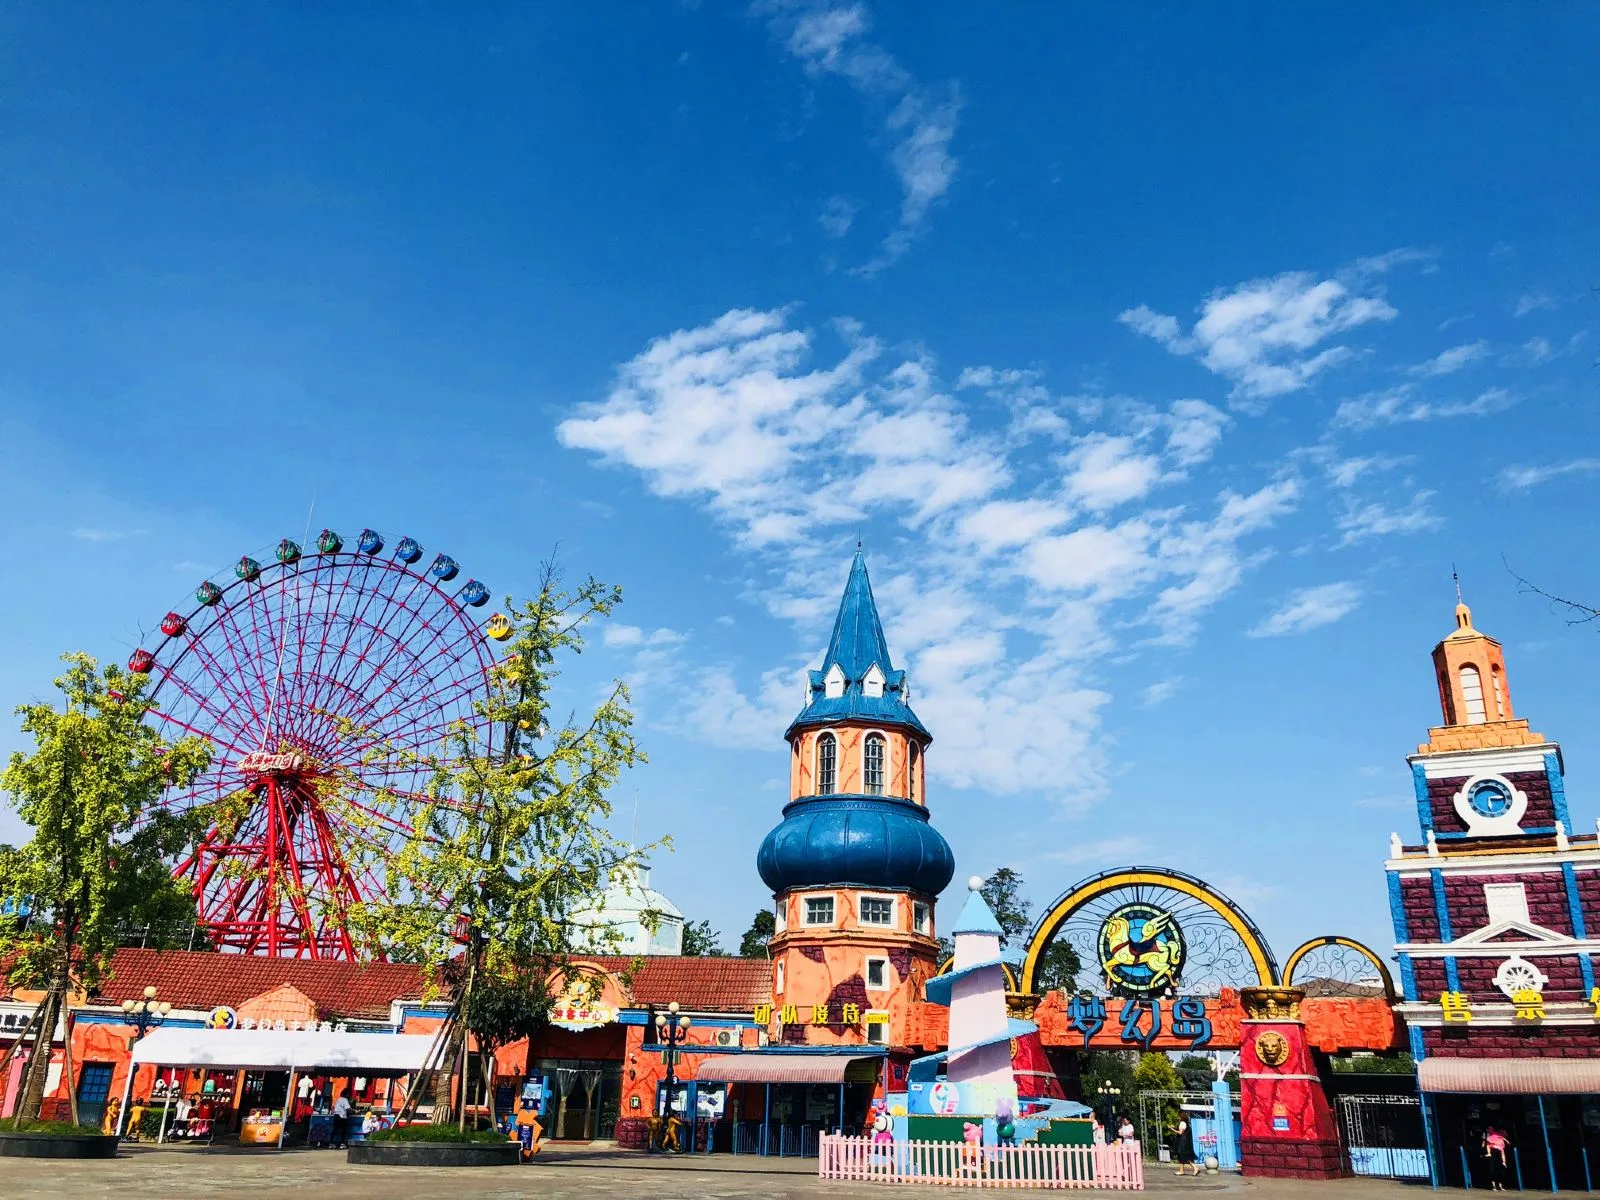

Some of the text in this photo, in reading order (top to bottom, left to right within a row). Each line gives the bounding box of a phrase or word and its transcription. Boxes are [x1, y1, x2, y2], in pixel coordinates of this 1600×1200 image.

[754, 1003, 860, 1025] 团队接待
[1067, 994, 1213, 1051] 梦幻岛
